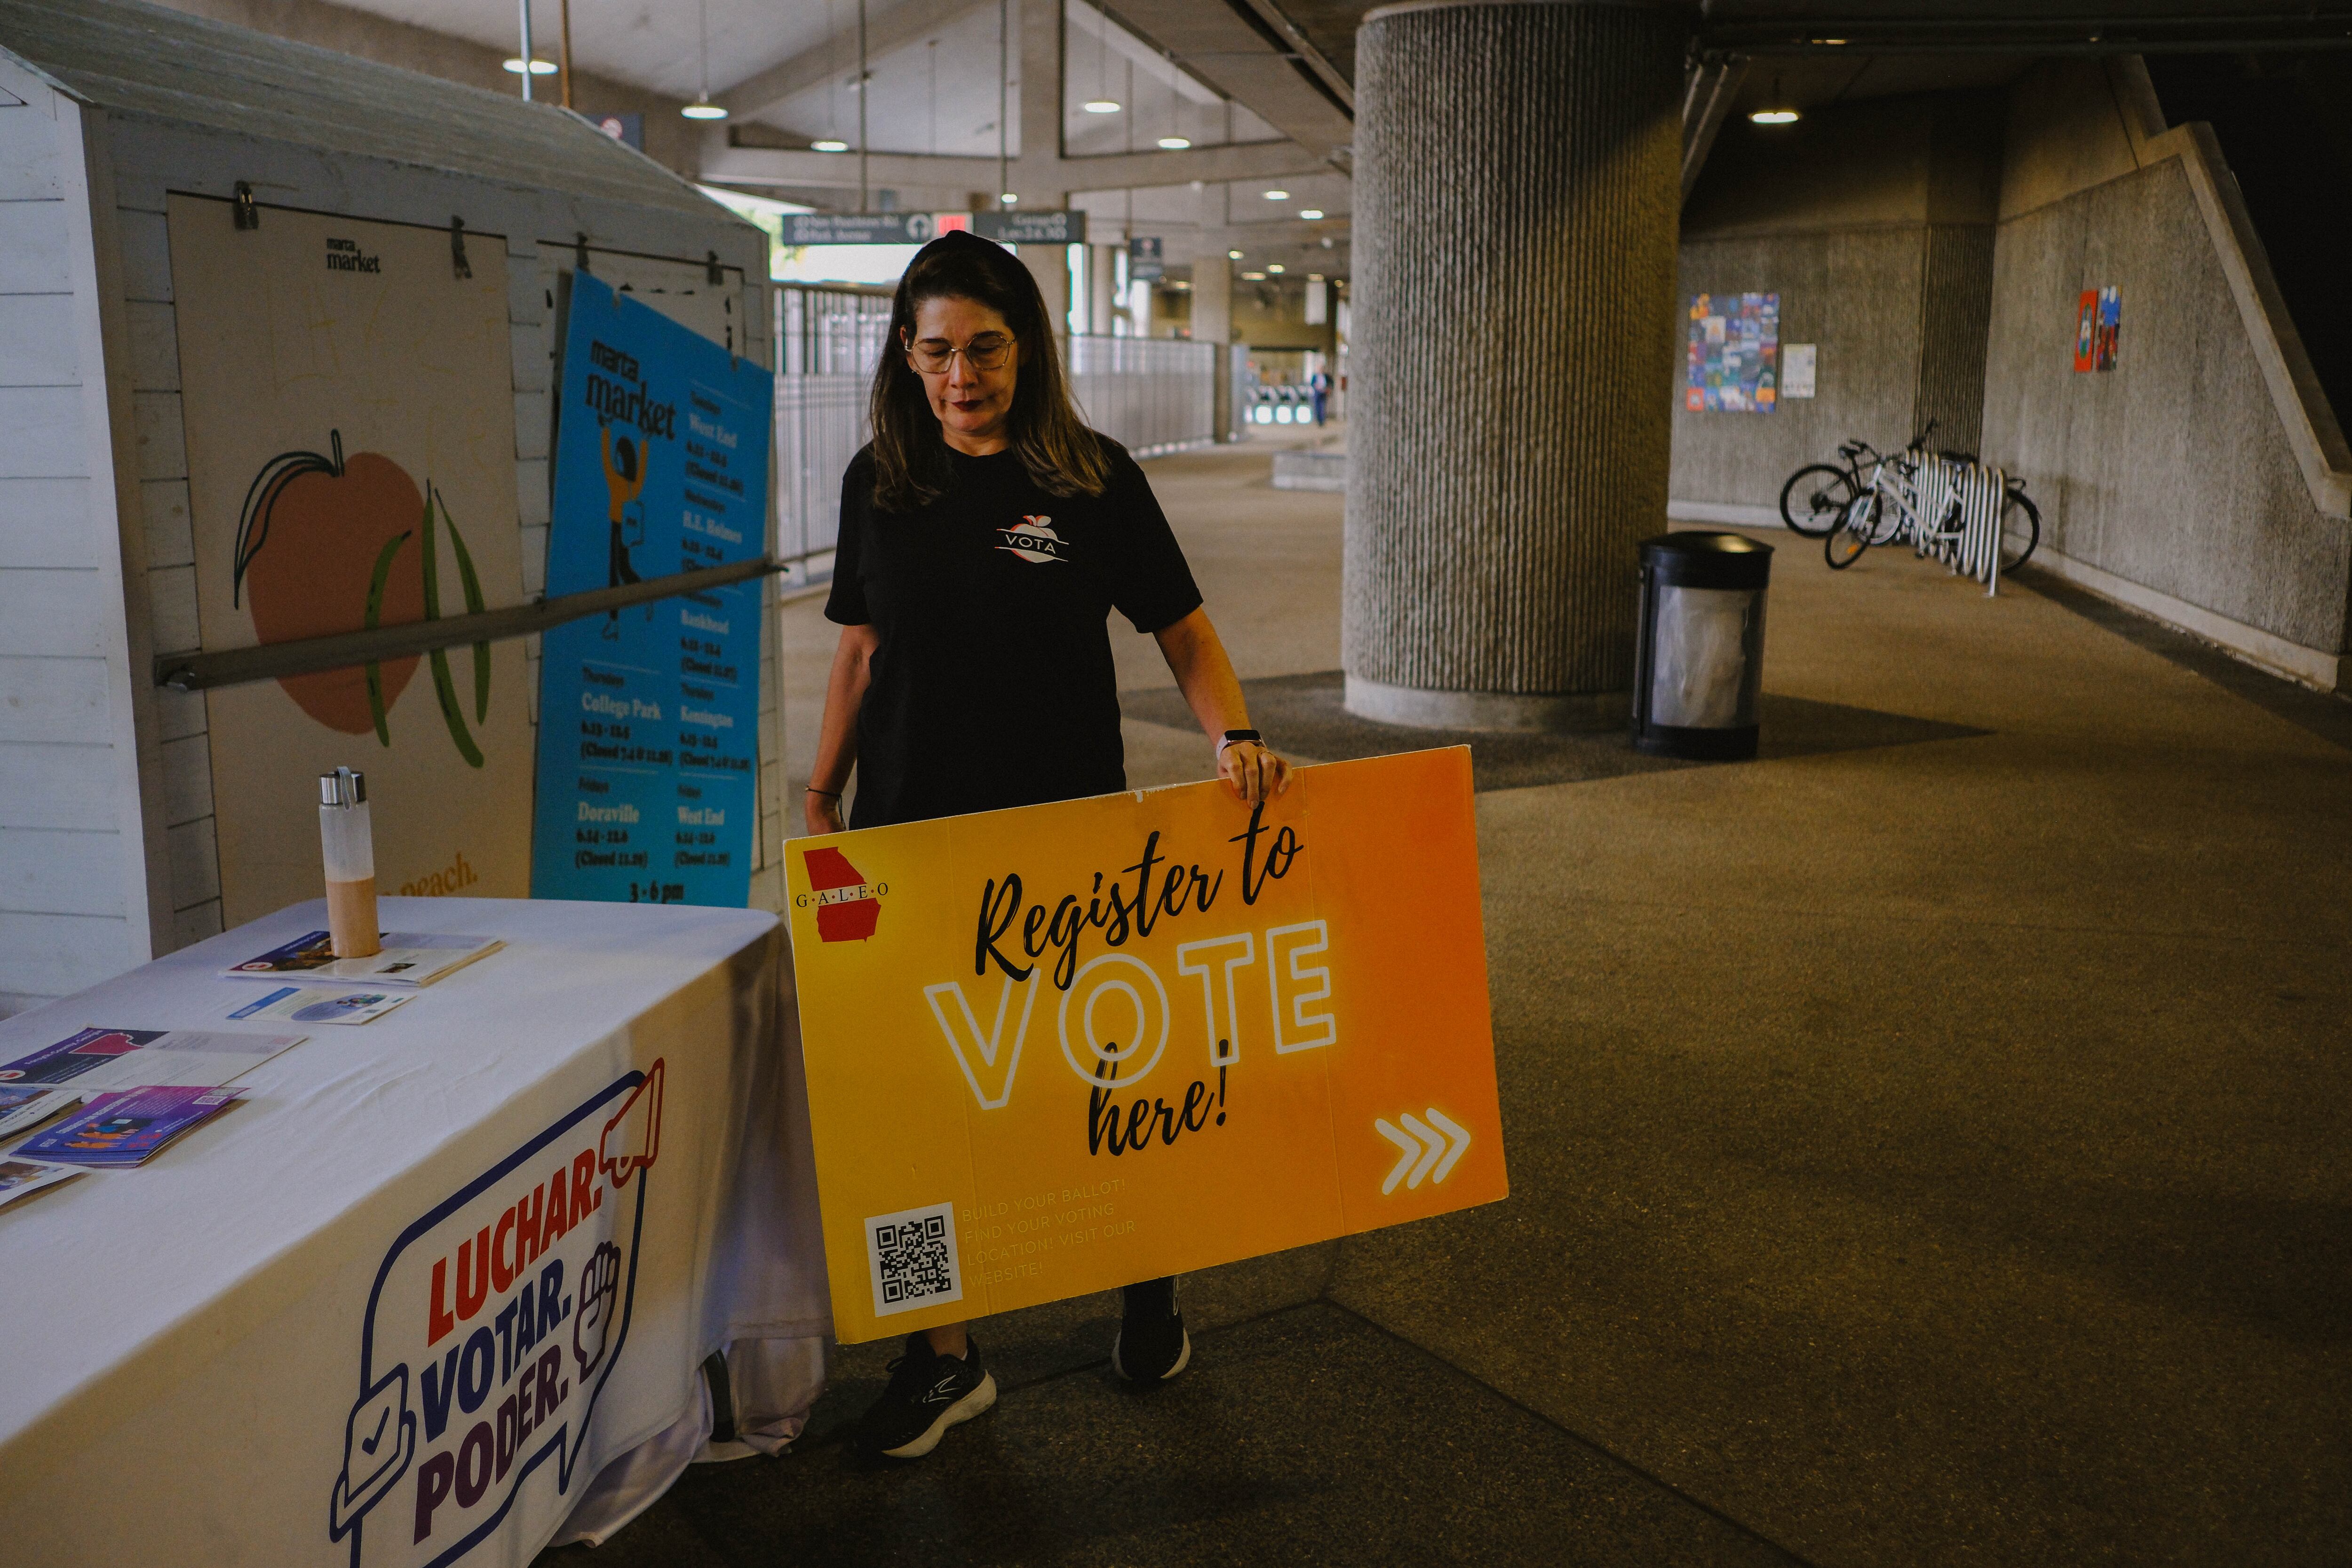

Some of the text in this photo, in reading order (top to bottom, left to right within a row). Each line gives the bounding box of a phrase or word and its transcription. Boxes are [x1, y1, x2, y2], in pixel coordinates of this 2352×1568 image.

[327, 249, 381, 273] market
[590, 339, 639, 382] marta
[585, 373, 675, 441] market
[1006, 534, 1056, 554] VOTA
[581, 692, 662, 720] College Park
[578, 801, 640, 823] Doraville
[650, 880, 659, 901] 6
[662, 884, 684, 904] pm
[976, 800, 1304, 991] Register to
[923, 919, 1337, 1109] VOTE
[1088, 1038, 1229, 1156] here!
[962, 1178, 1127, 1223] BUILD YOUR BALLOT!
[964, 1202, 1115, 1244] FIND YOUR VOTING
[427, 1148, 602, 1348] LUCHAR.
[967, 1220, 1136, 1266] LOCATION! VISIT OUR
[969, 1261, 1044, 1288] WEBSITE!
[420, 1258, 572, 1445] VOTAR.
[413, 1344, 569, 1546] PODER.
